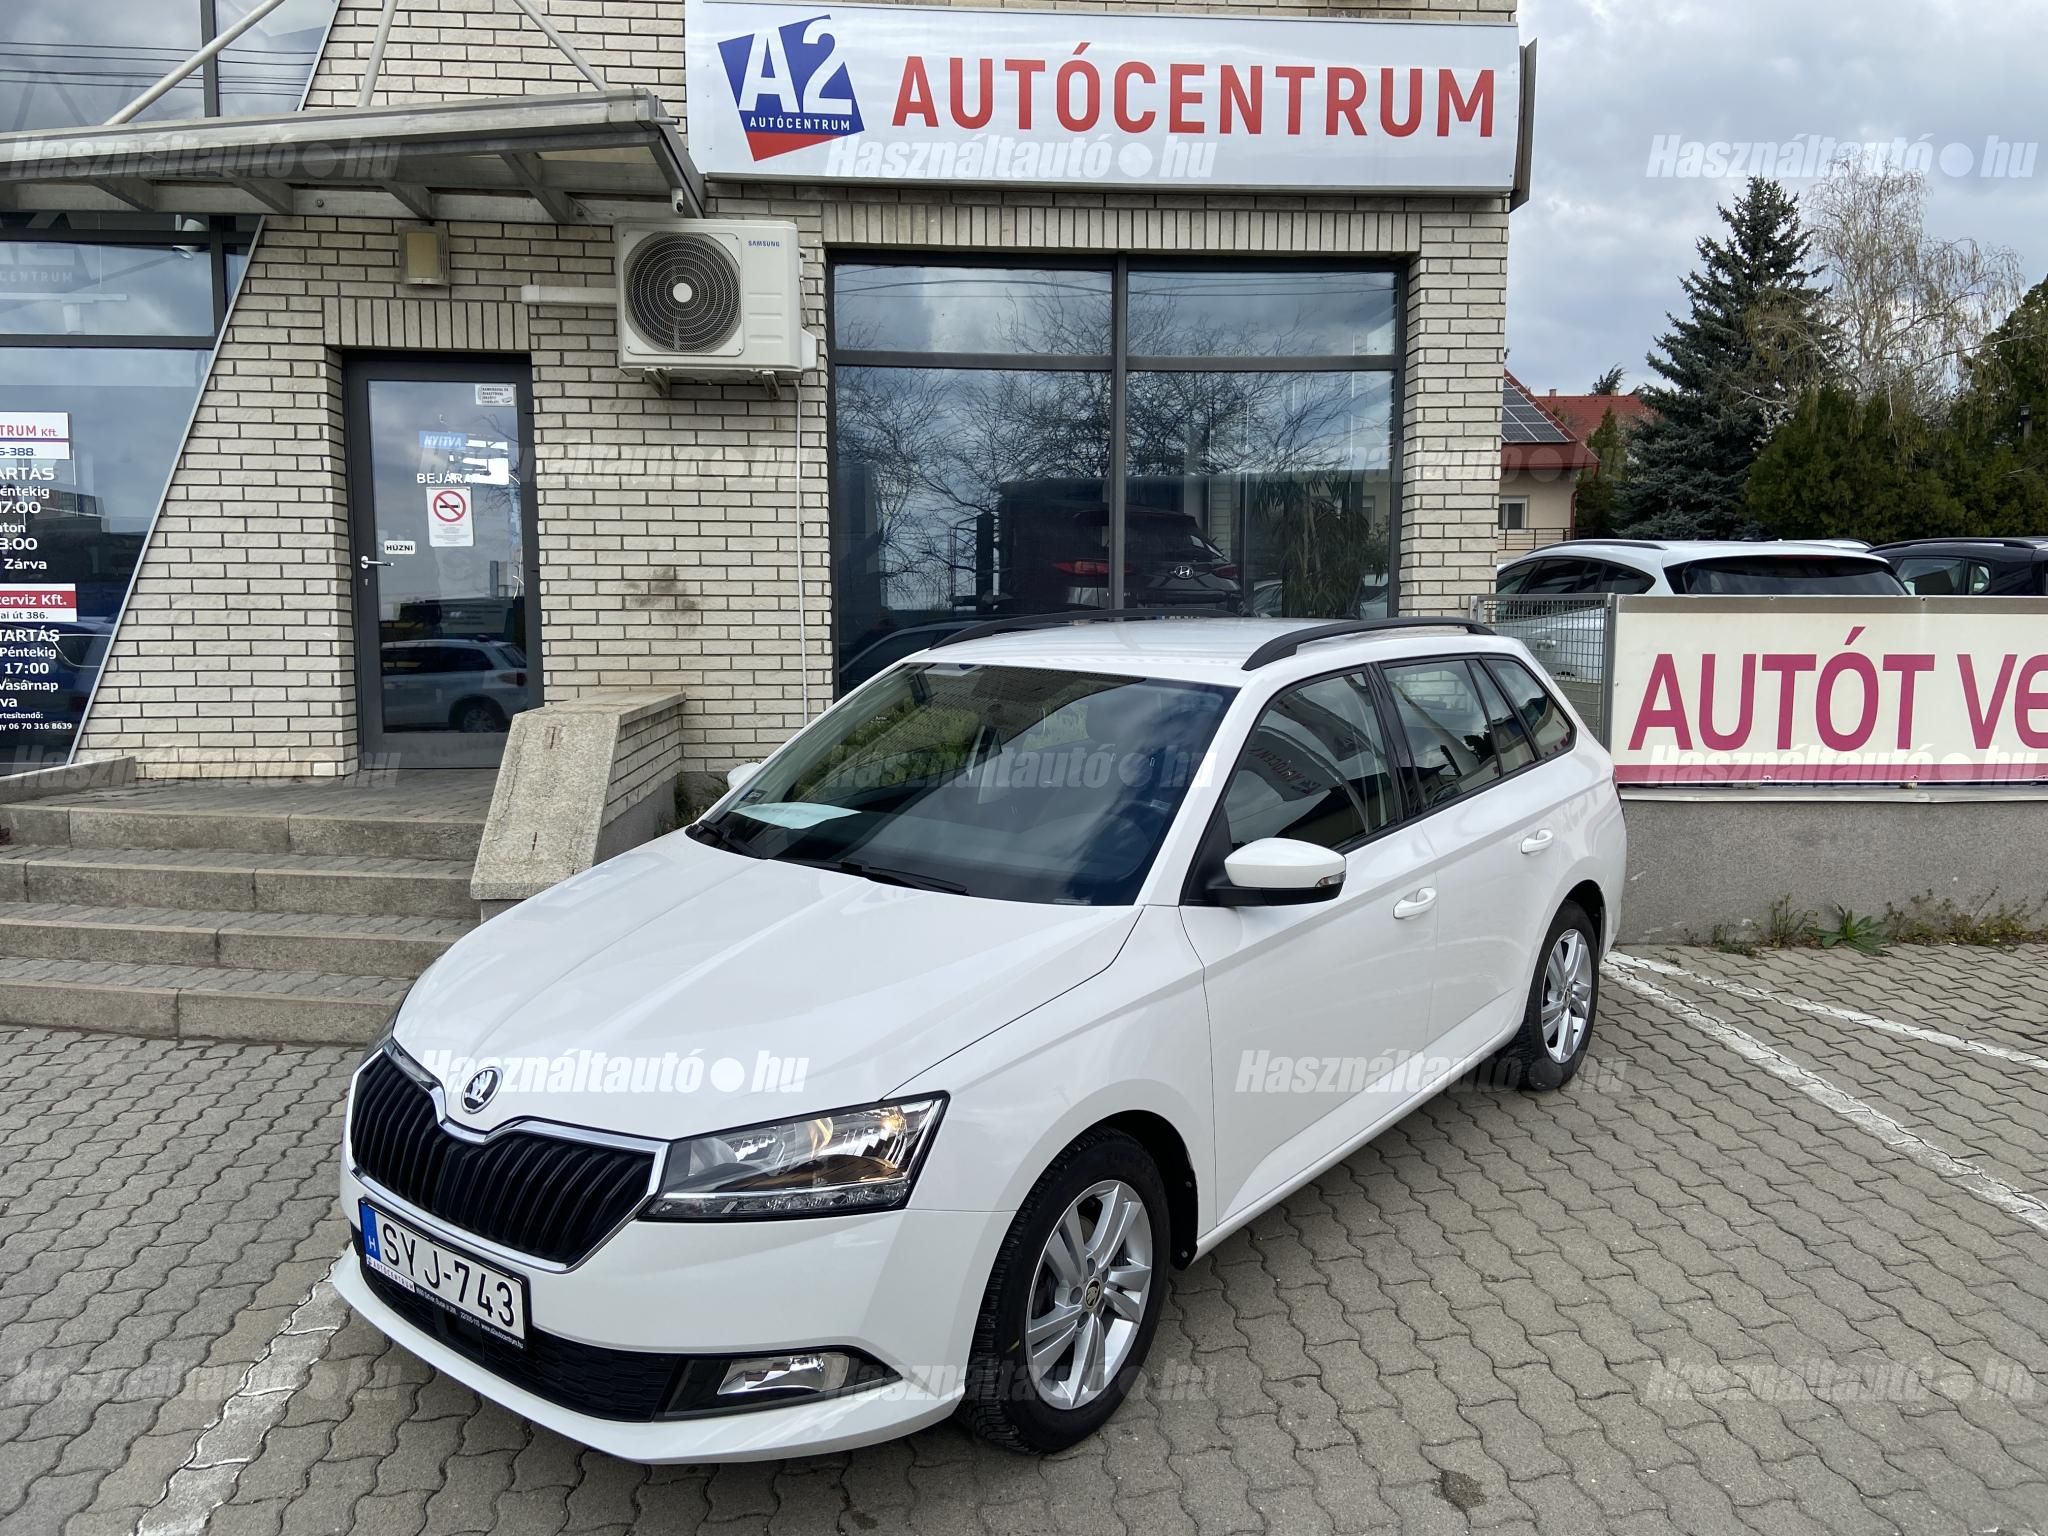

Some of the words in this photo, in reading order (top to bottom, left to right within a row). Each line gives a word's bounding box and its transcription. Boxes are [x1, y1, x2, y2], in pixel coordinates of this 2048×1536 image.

[738, 18, 853, 115] A2
[892, 42, 1494, 138] AUTÓCENTRUM
[750, 115, 850, 131] AUTÓCENTRUM
[3, 558, 48, 570] Zárva
[41, 594, 67, 606] Kft.
[12, 610, 24, 620] út
[26, 611, 49, 620] 386.
[4, 662, 50, 675] 17:00
[1628, 626, 1936, 752] AUTÓT
[8, 722, 19, 730] 06
[21, 722, 32, 730] 70
[33, 722, 50, 730] 316
[51, 722, 73, 730] 8639
[368, 1235, 377, 1252] H
[382, 1222, 515, 1328] SYJ-743
